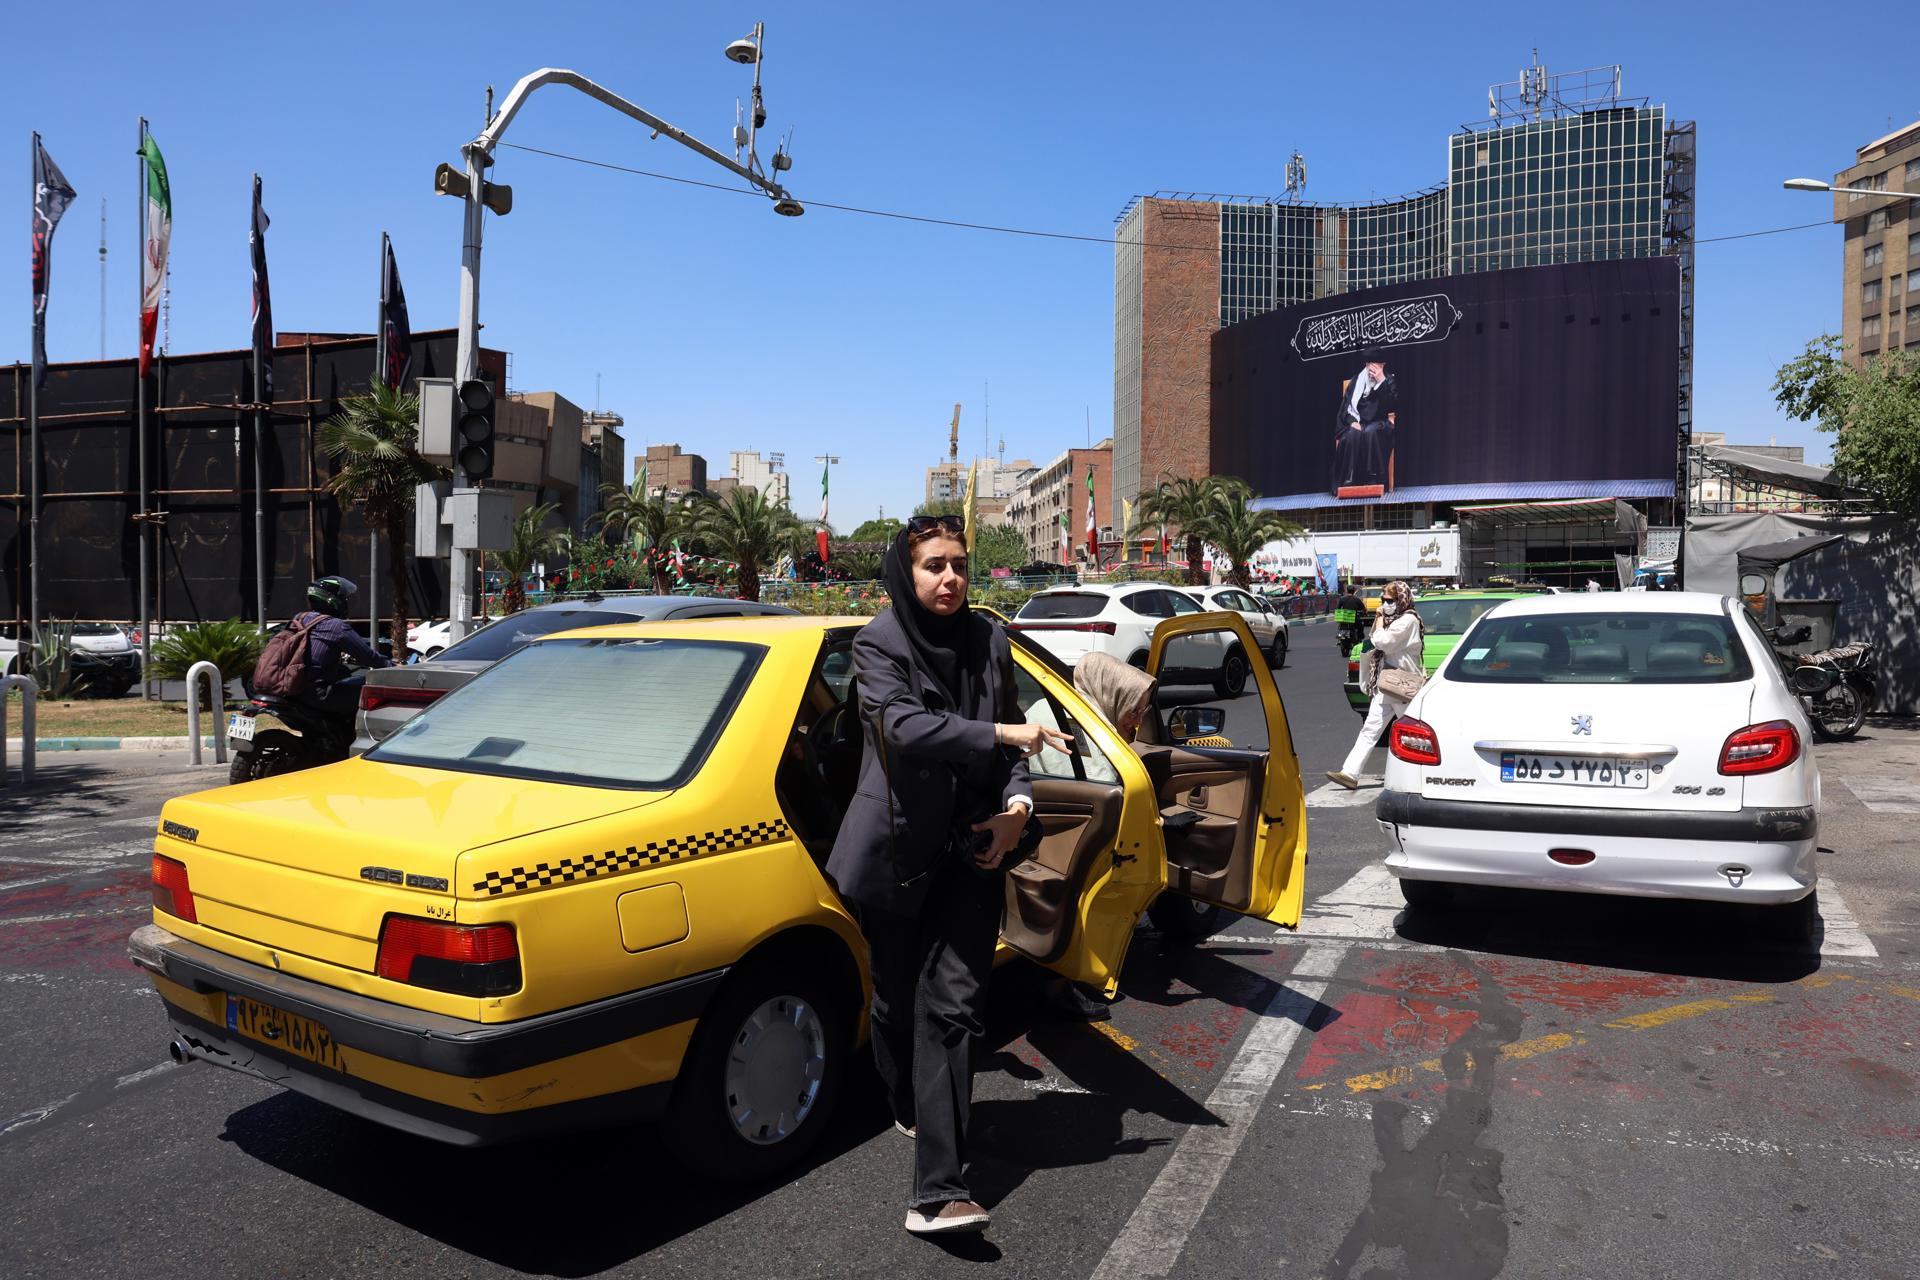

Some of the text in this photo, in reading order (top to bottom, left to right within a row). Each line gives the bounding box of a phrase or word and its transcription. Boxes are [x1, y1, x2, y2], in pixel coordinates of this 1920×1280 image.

[1282, 557, 1313, 567] DIAMOND
[1516, 758, 1612, 782] ۵۵ د ۲۷۵
[1426, 776, 1476, 787] PEUGEOT
[1672, 786, 1726, 796] 206 SD
[163, 819, 200, 842] PEUGEOT
[360, 866, 449, 893] 405 GLX
